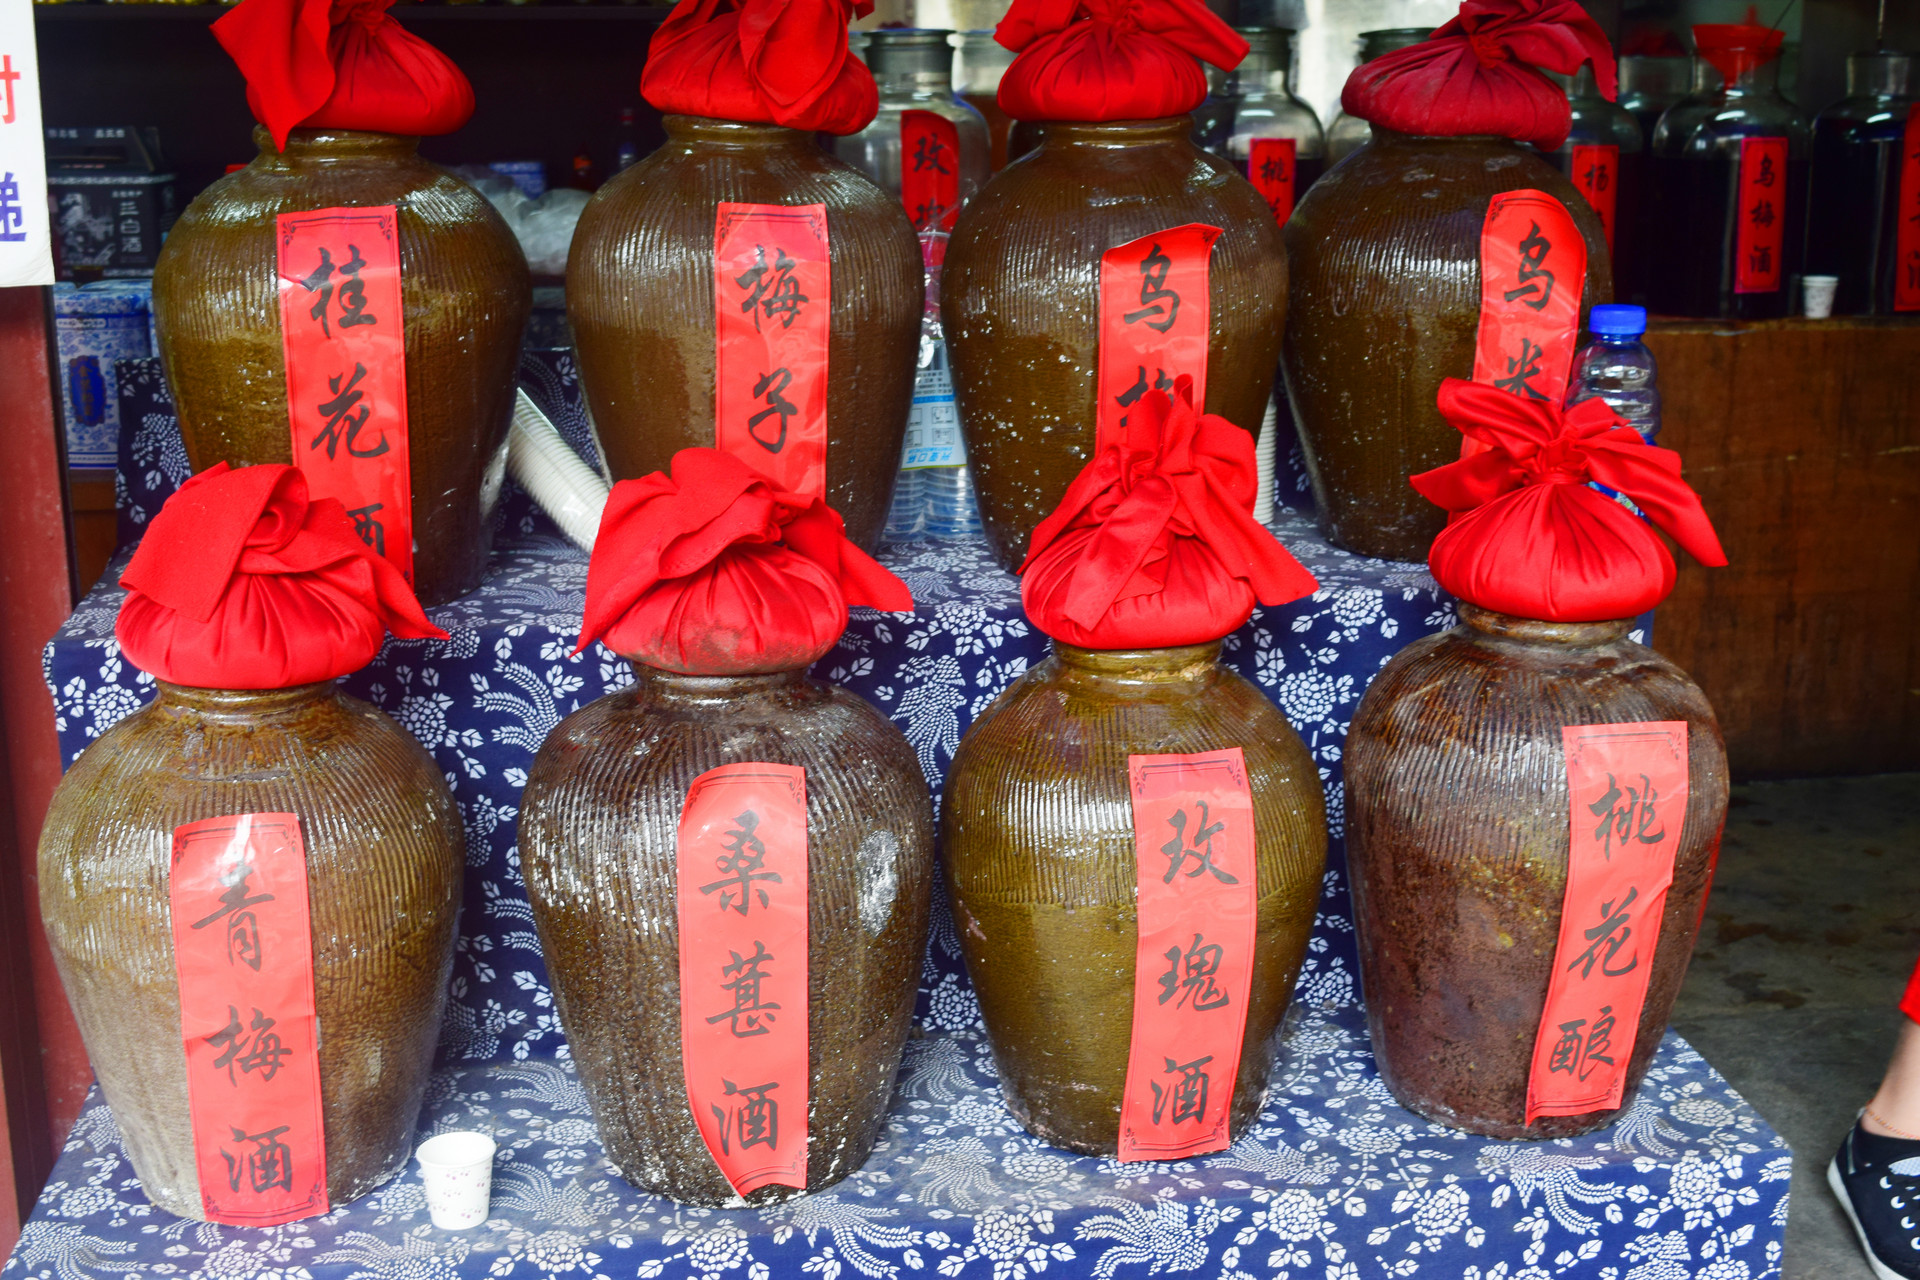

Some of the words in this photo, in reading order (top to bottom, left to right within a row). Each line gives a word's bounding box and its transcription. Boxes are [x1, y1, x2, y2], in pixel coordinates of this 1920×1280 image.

[734, 243, 809, 454] 梅子
[1494, 218, 1555, 402] 乌米
[1750, 153, 1776, 275] 乌梅酒
[190, 855, 293, 1194] 青梅酒
[700, 809, 783, 1156] 桑葚酒
[1150, 800, 1239, 1127] 玫瑰酒
[1548, 772, 1667, 1082] 桃花酿
